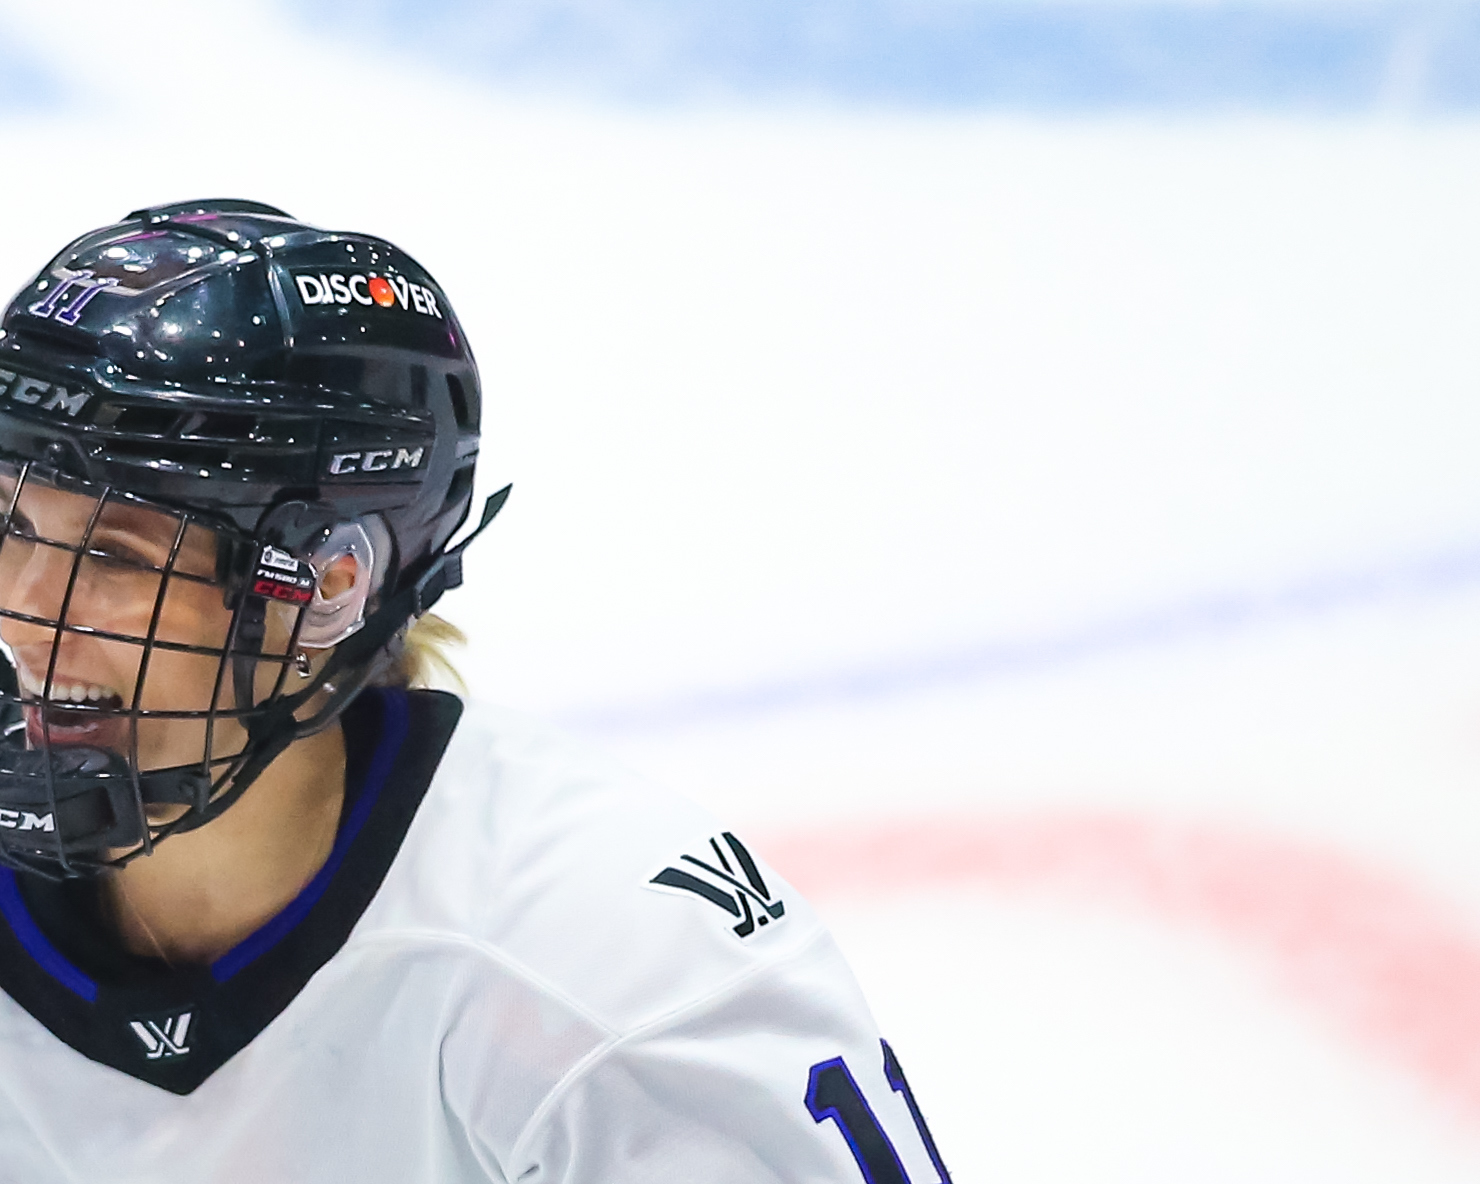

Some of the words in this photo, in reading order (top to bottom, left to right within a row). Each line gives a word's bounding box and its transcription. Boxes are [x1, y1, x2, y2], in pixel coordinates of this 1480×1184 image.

[28, 268, 121, 326] 11
[295, 271, 443, 319] DISCOVER
[329, 446, 426, 475] CCM
[253, 580, 313, 602] CCM
